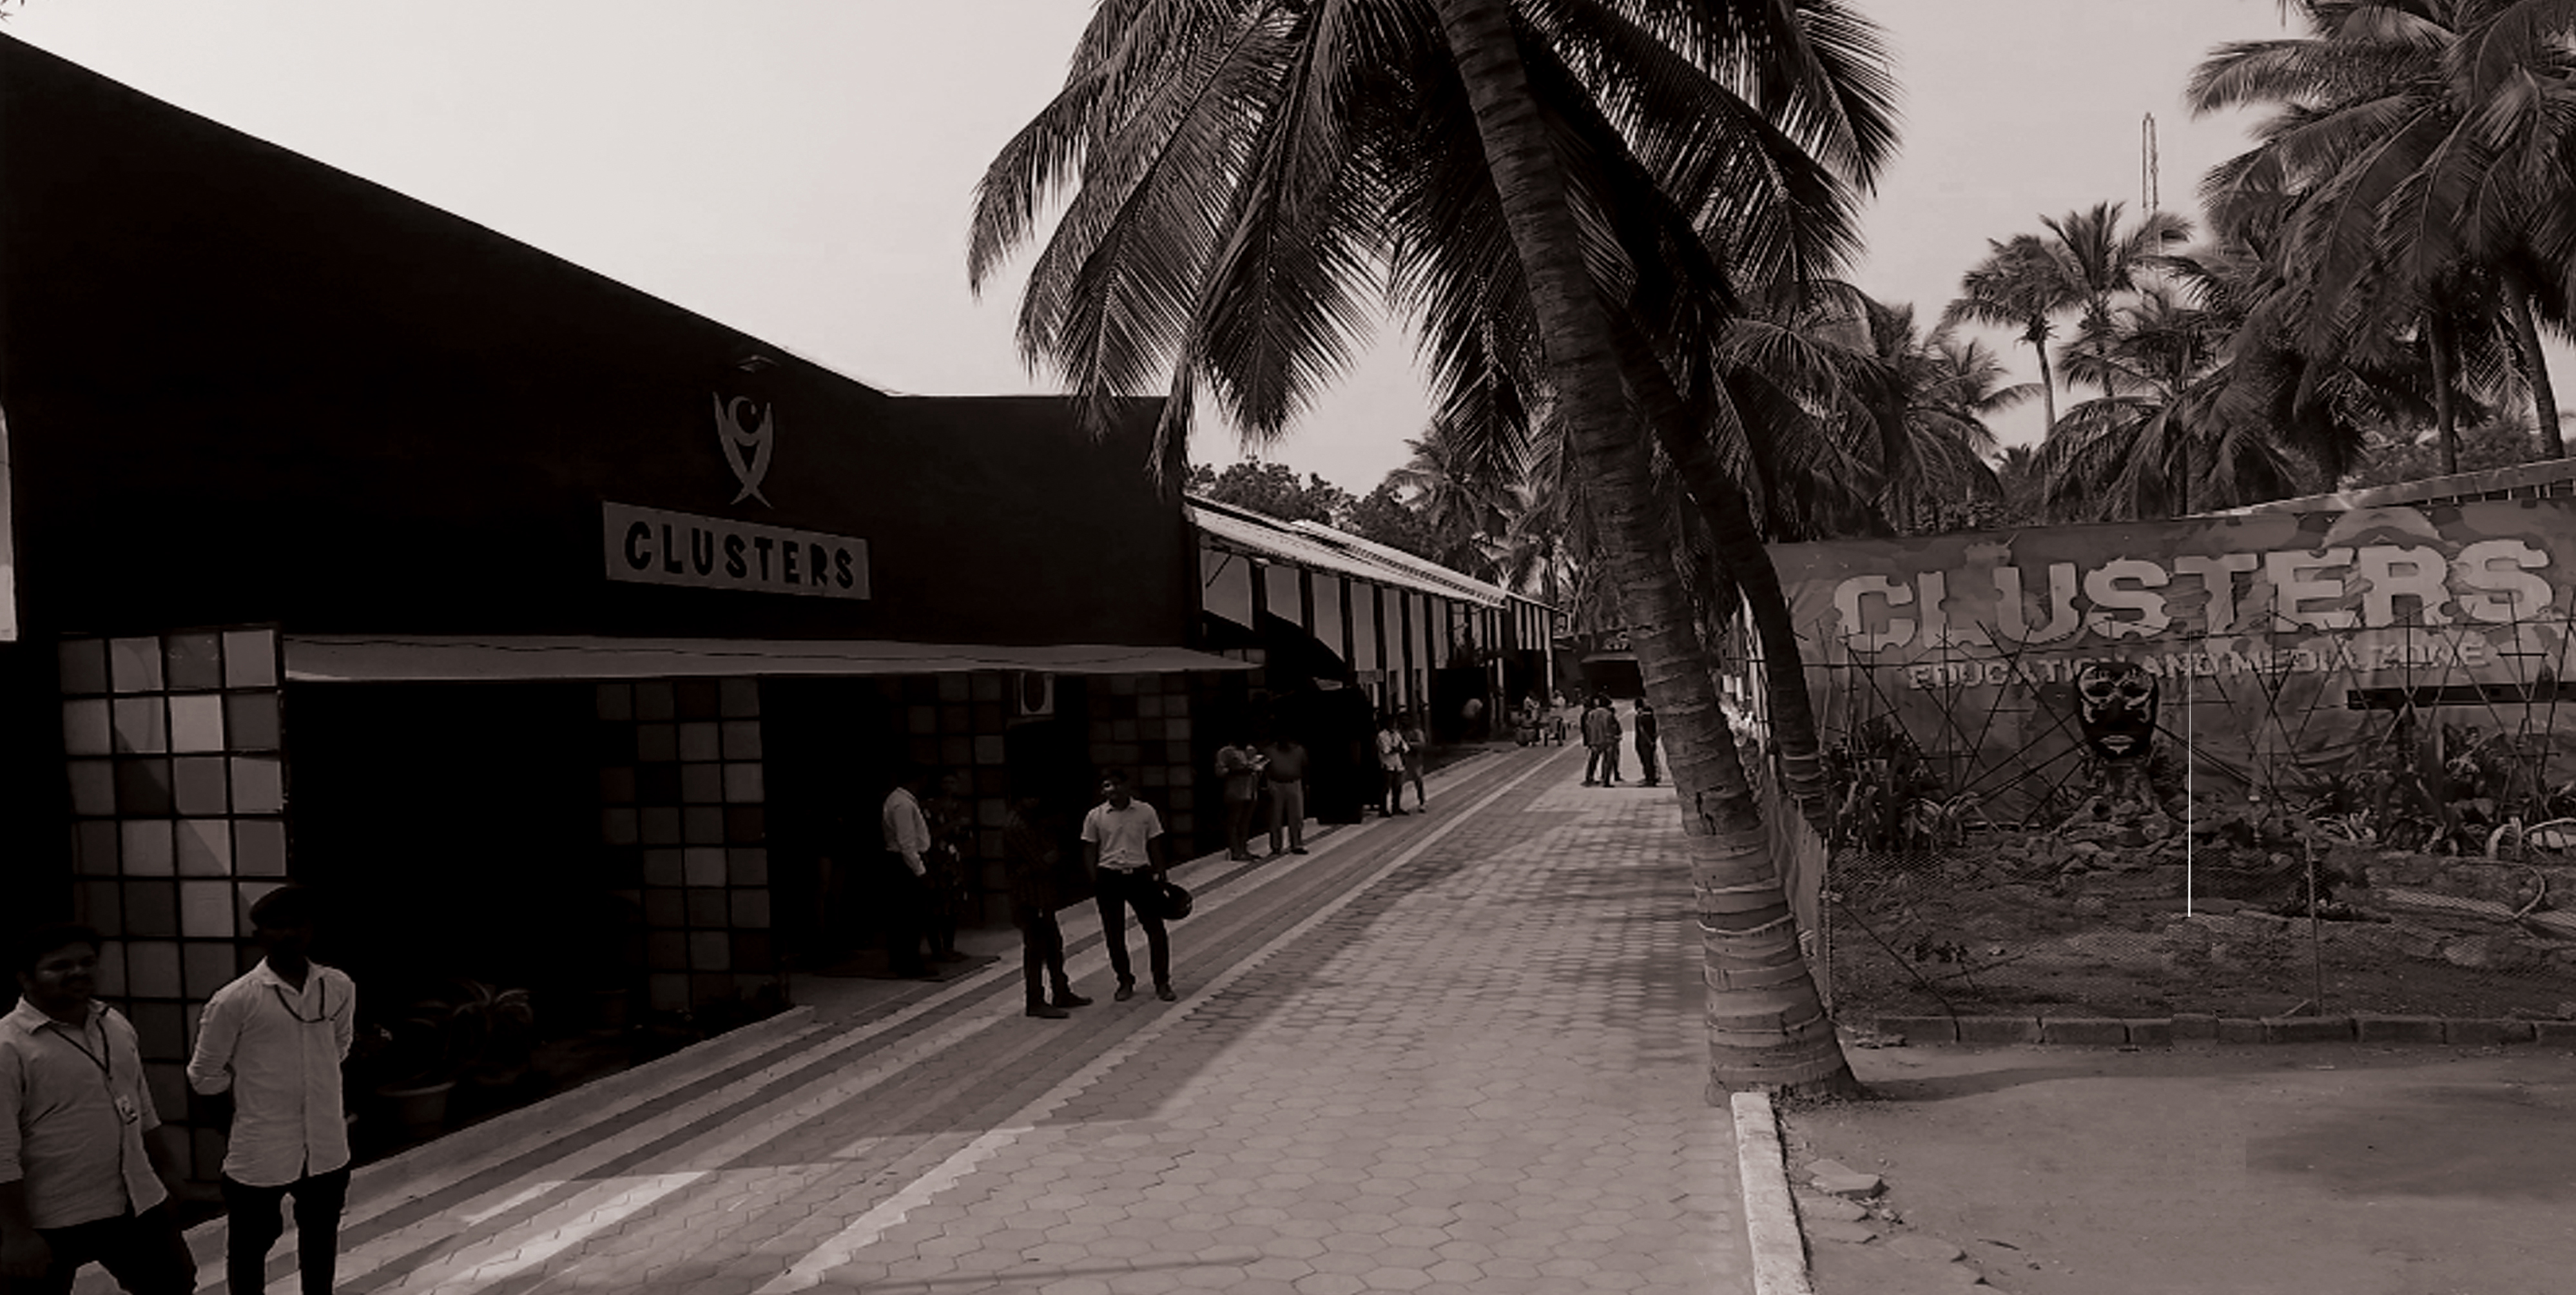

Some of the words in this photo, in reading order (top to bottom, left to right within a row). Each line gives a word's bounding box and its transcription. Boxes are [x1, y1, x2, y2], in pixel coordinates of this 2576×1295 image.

[625, 521, 854, 589] CLUSTERS
[1833, 539, 2553, 652] CLUSTERS
[1908, 654, 2127, 688] EDUCATI
[2141, 651, 2218, 677] AND
